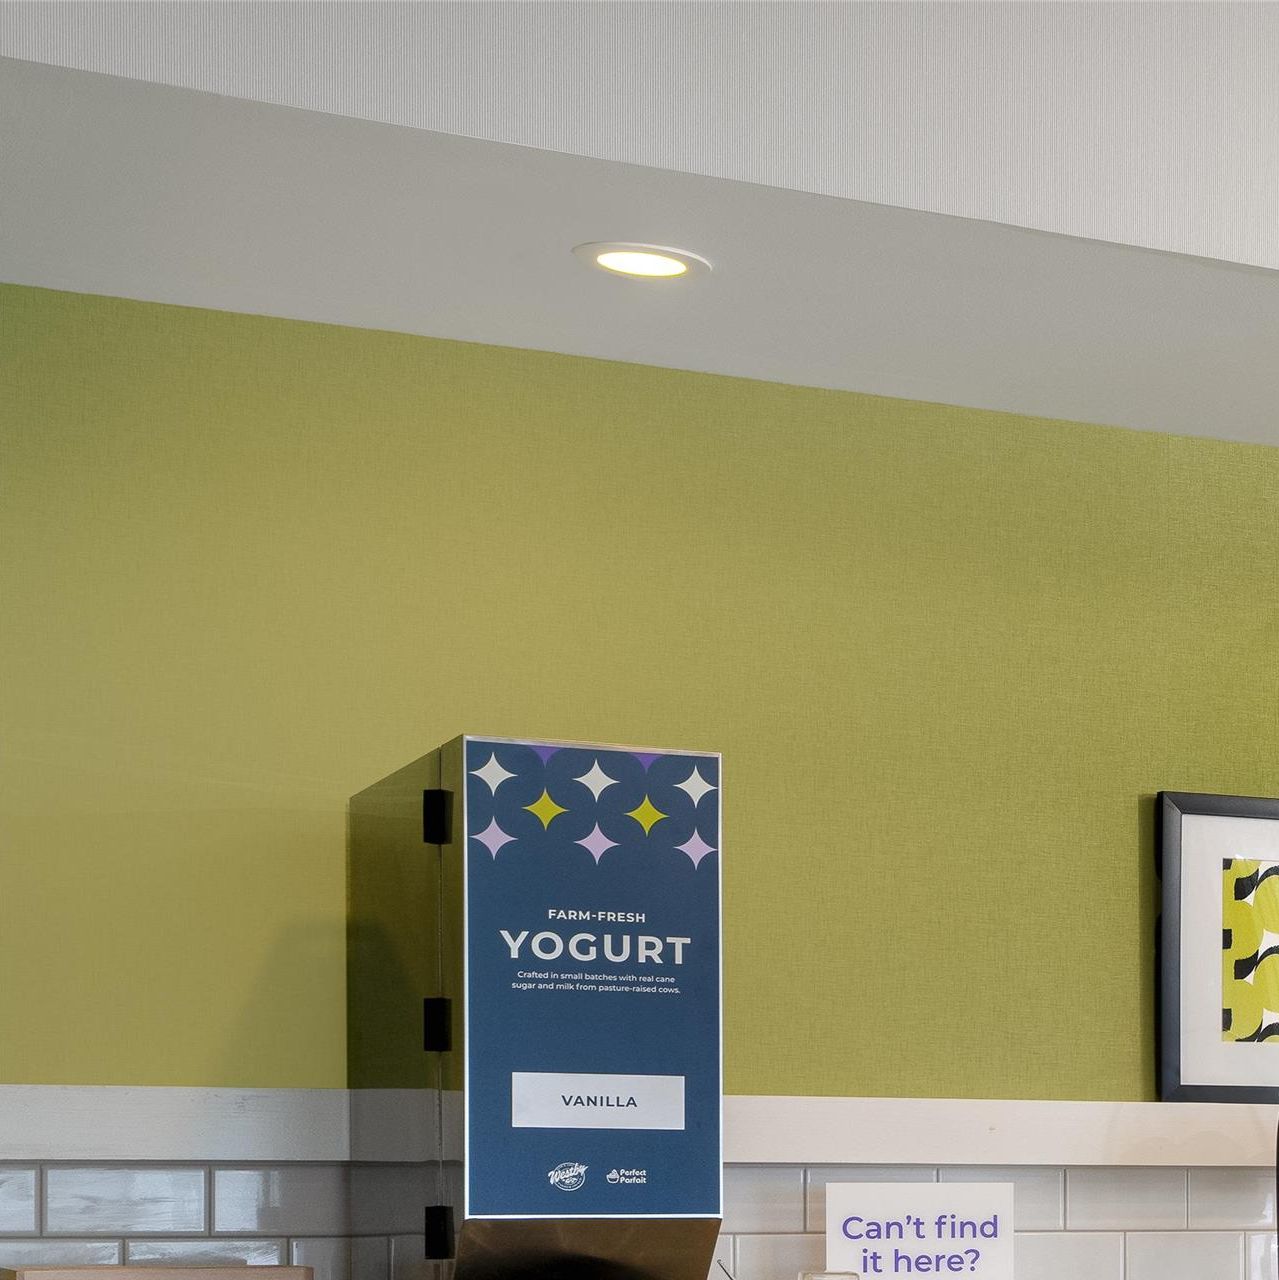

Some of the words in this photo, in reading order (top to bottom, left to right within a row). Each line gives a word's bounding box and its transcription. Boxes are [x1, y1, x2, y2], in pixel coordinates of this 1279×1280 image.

[547, 908, 646, 924] FARM-FRESH
[499, 929, 692, 966] YOGURT
[517, 970, 549, 980] Crafted
[550, 971, 559, 980] in
[560, 972, 583, 981] small
[584, 972, 618, 982] batches
[618, 974, 638, 983] with
[638, 975, 654, 983] real
[655, 976, 676, 984] cane
[511, 982, 536, 991] sugar
[537, 982, 554, 990] and
[555, 983, 575, 991] milk
[576, 983, 597, 992] from
[598, 984, 657, 994] pasture-raised
[657, 986, 681, 994] cows.
[561, 1094, 638, 1108] VANILLA
[619, 1168, 647, 1177] Perfect
[619, 1176, 647, 1185] Parfait
[842, 1214, 926, 1240] Can't
[934, 1214, 999, 1239] find
[861, 1248, 883, 1274] it
[893, 1248, 981, 1273] here?
